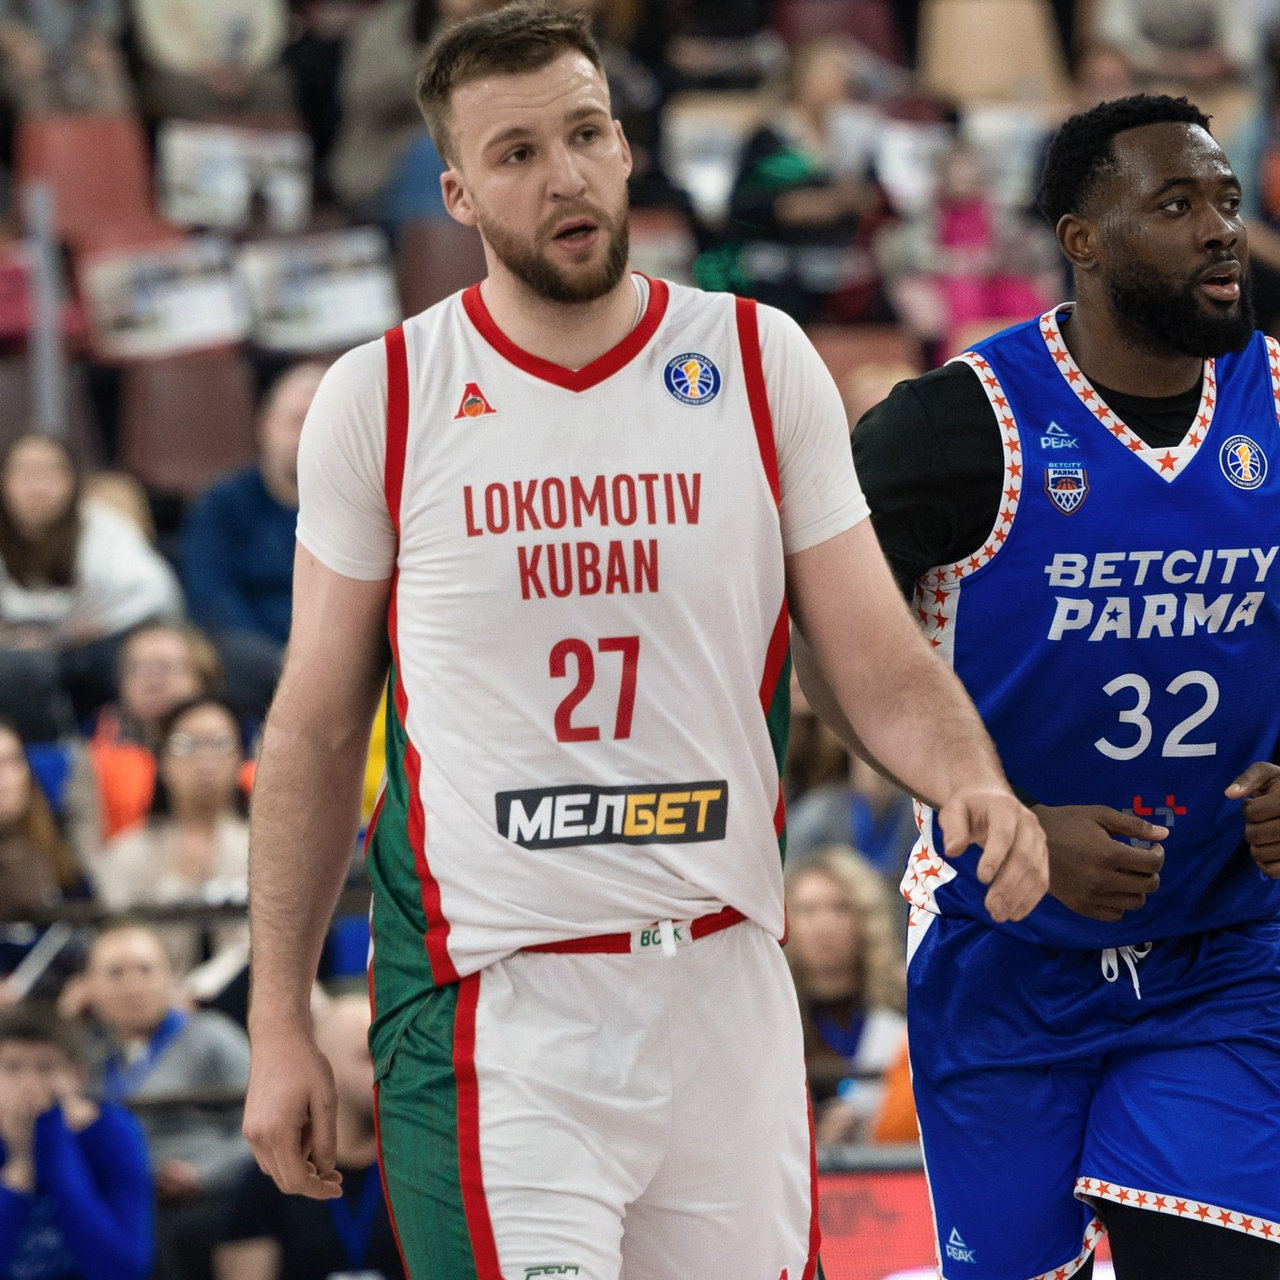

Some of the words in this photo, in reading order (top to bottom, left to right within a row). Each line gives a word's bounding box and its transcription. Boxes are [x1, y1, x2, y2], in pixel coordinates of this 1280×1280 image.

[1040, 436, 1080, 450] PEAK
[1052, 469, 1079, 477] PARMA
[463, 472, 702, 538] LOKOMOTIV
[516, 538, 660, 601] KUBAN
[1044, 545, 1280, 588] BETCITY
[1046, 590, 1266, 643] PARMA
[548, 634, 641, 744] 27
[1093, 669, 1221, 761] 32
[507, 788, 723, 843] МЕЛБЕТ
[945, 1243, 977, 1264] PEAK
